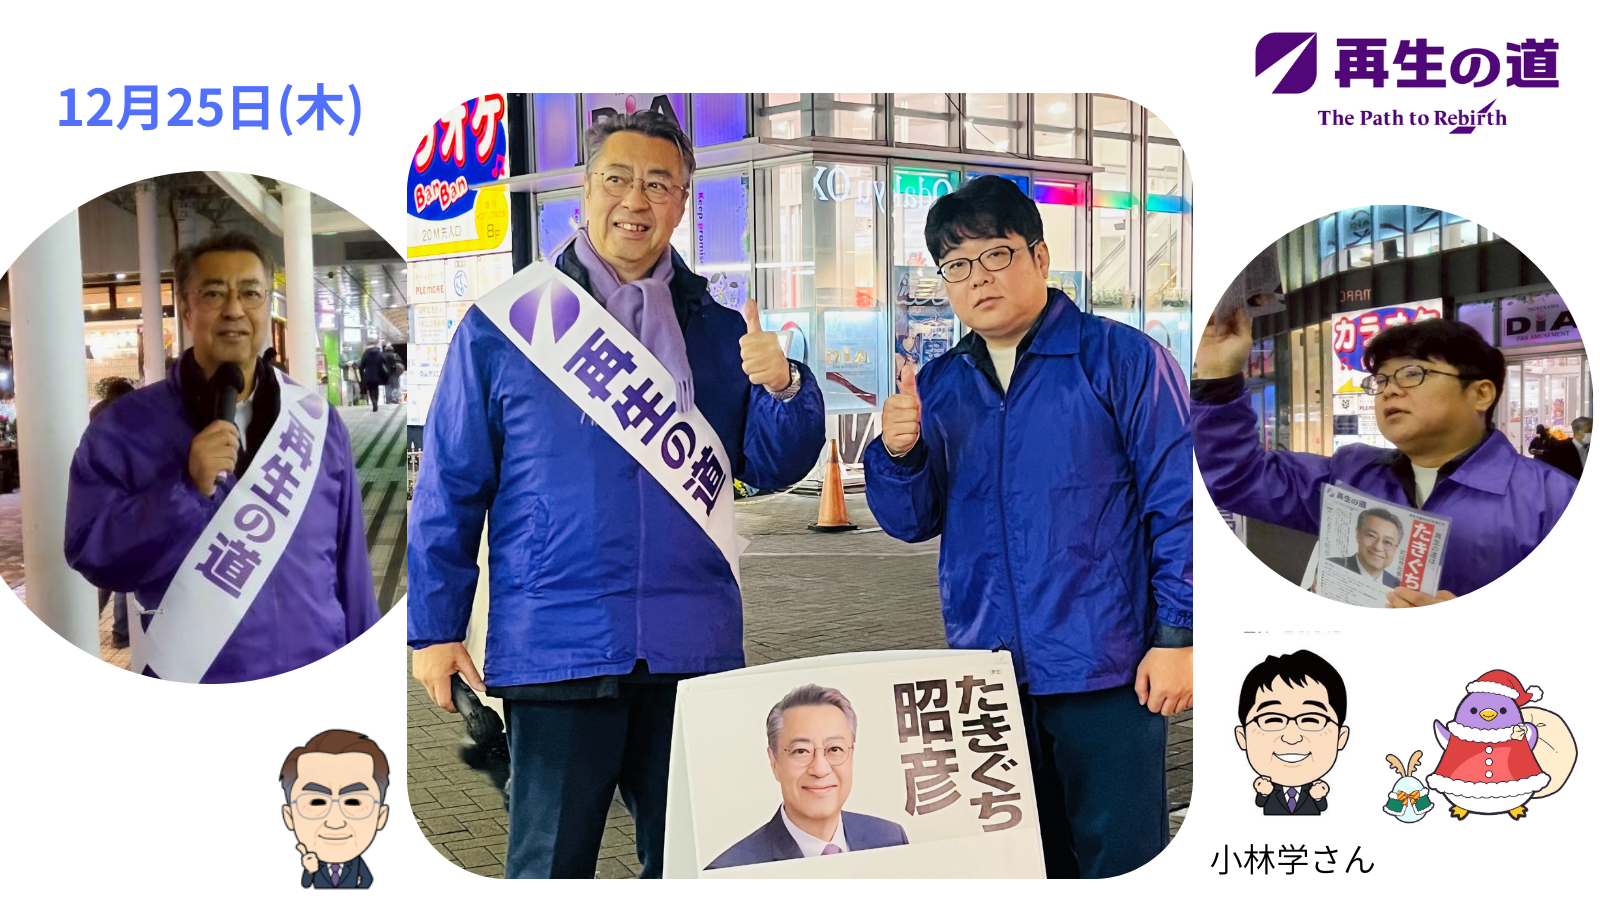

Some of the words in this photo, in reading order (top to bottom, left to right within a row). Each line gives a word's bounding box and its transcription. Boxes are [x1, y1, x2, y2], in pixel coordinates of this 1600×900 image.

[486, 223, 501, 239] 8F
[1529, 331, 1570, 340] AMUSEMENT
[563, 327, 727, 517] 再生の道
[195, 410, 316, 599] 再生の道
[1405, 523, 1432, 590] たきぐち
[893, 678, 962, 817] 昭彦
[955, 674, 1023, 833] たきぐち
